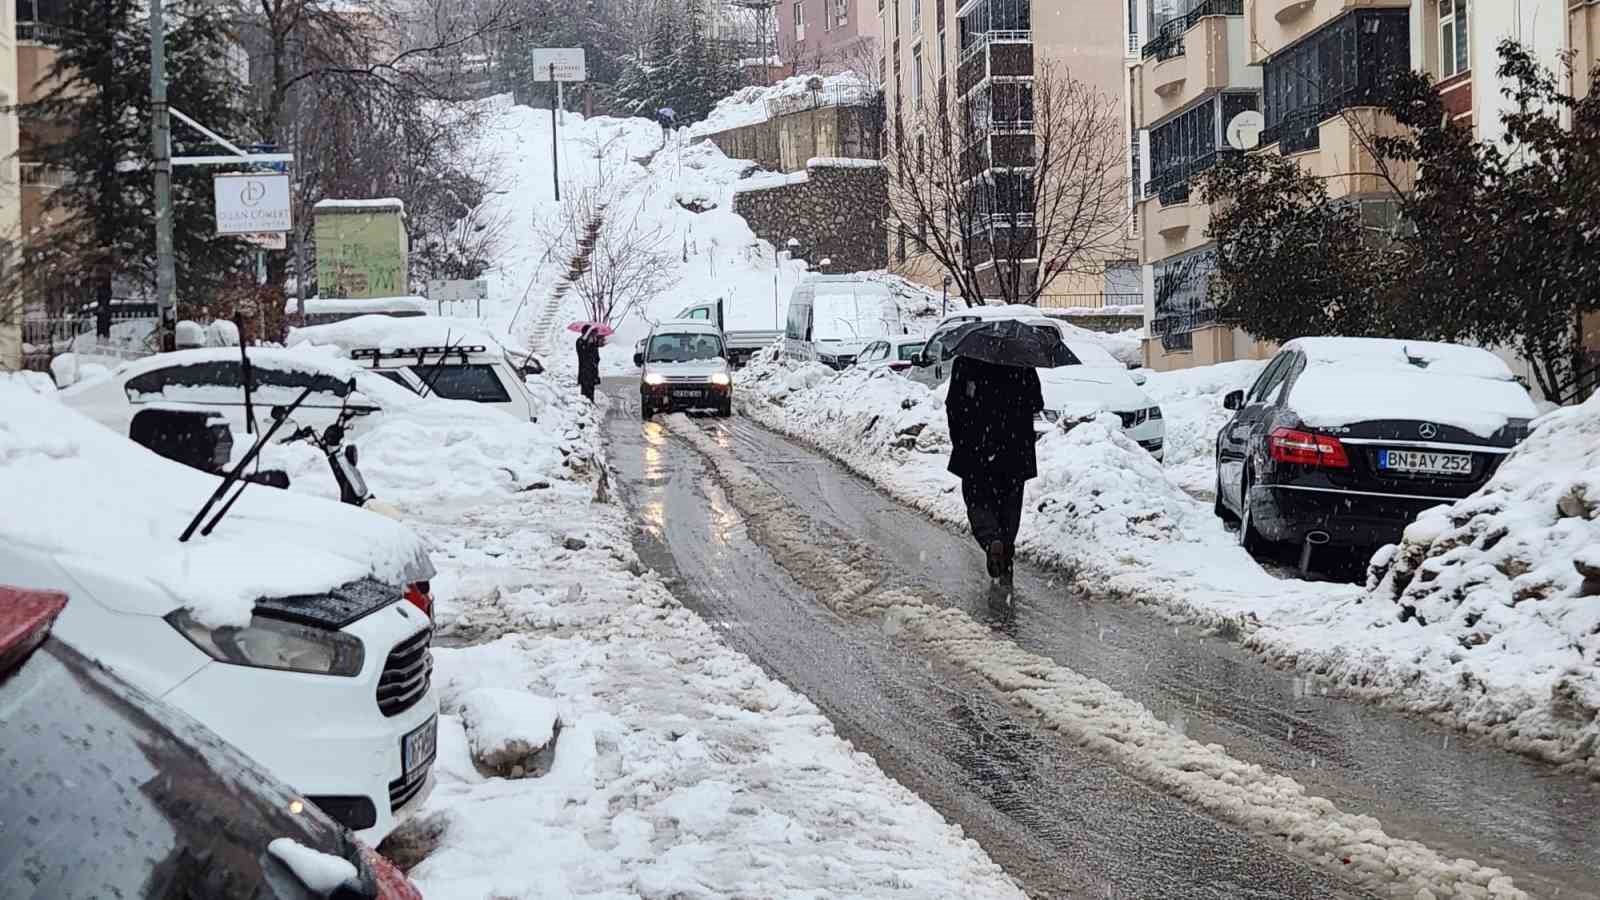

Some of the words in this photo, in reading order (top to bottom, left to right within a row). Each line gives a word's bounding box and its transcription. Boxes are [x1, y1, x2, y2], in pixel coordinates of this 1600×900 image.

[1388, 452, 1408, 467] BN
[1419, 455, 1437, 468] AY
[1441, 456, 1470, 471] 252
